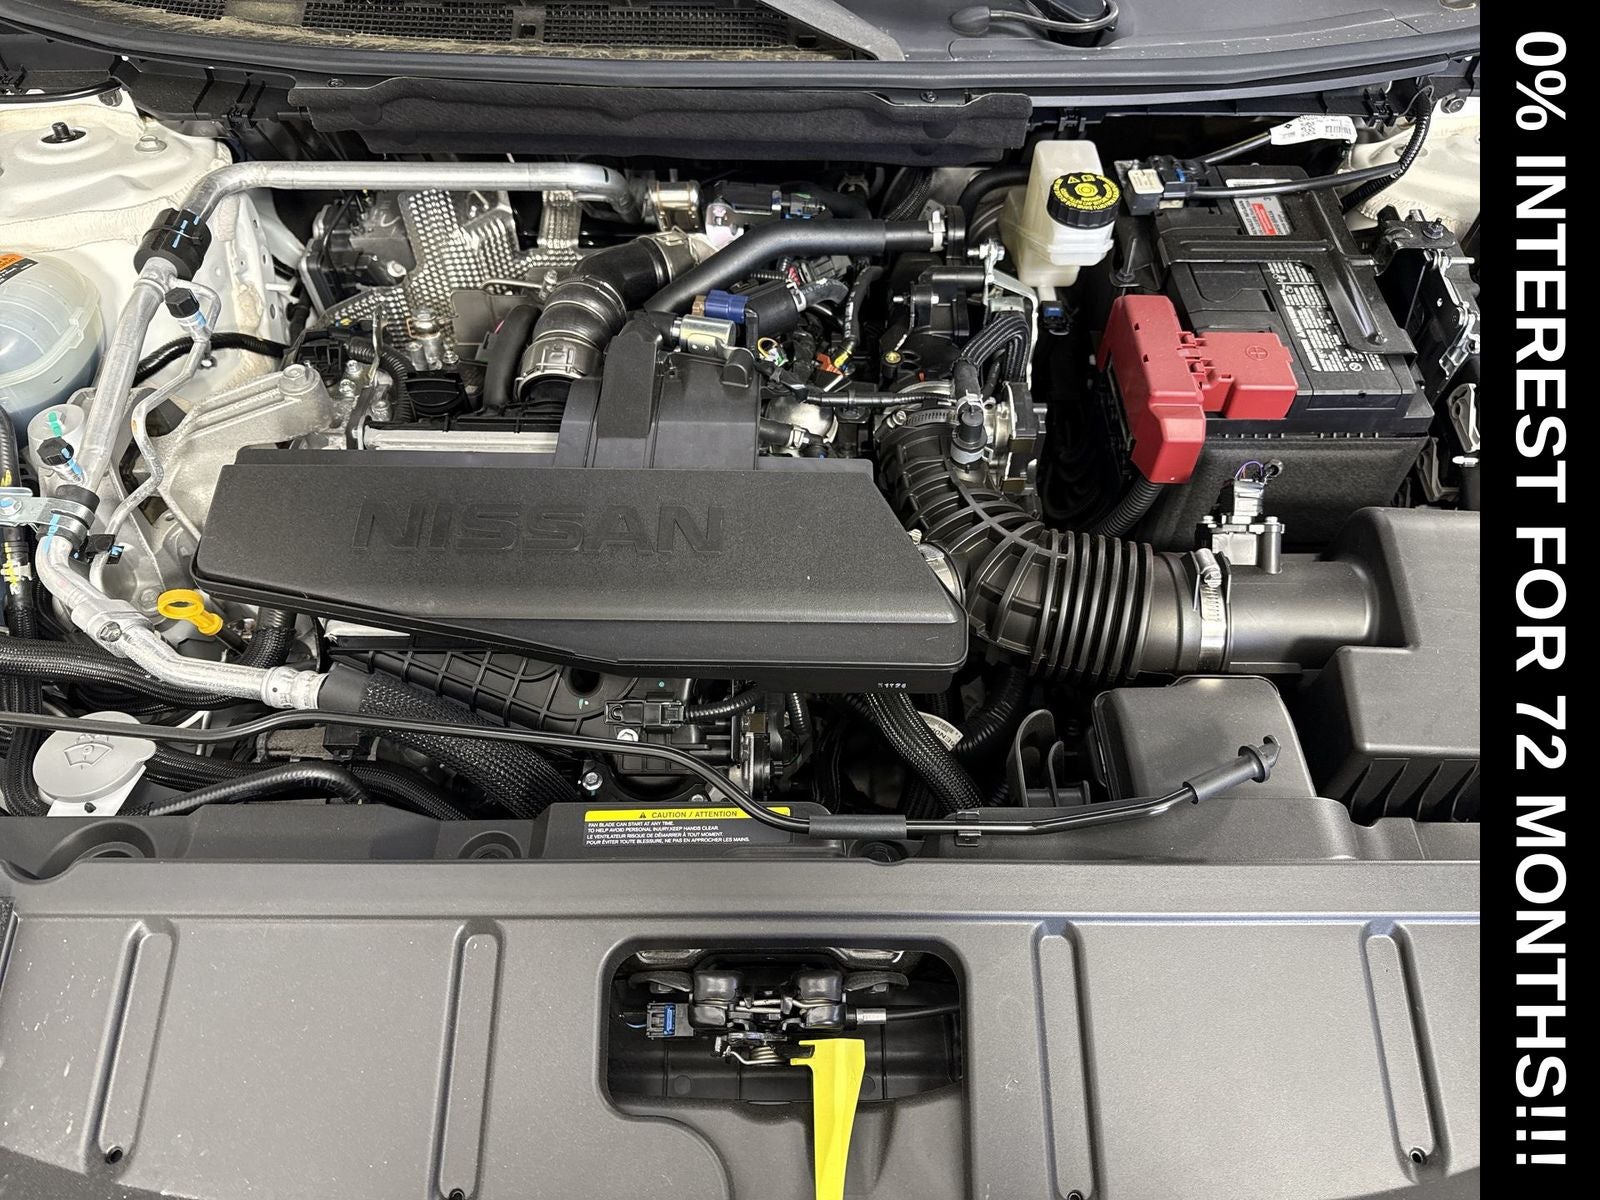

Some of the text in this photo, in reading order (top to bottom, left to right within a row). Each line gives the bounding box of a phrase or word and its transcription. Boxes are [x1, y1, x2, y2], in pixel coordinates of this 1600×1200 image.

[352, 502, 724, 554] NISSAN
[651, 811, 687, 819] CAUTION
[694, 810, 738, 818] ATTENTION
